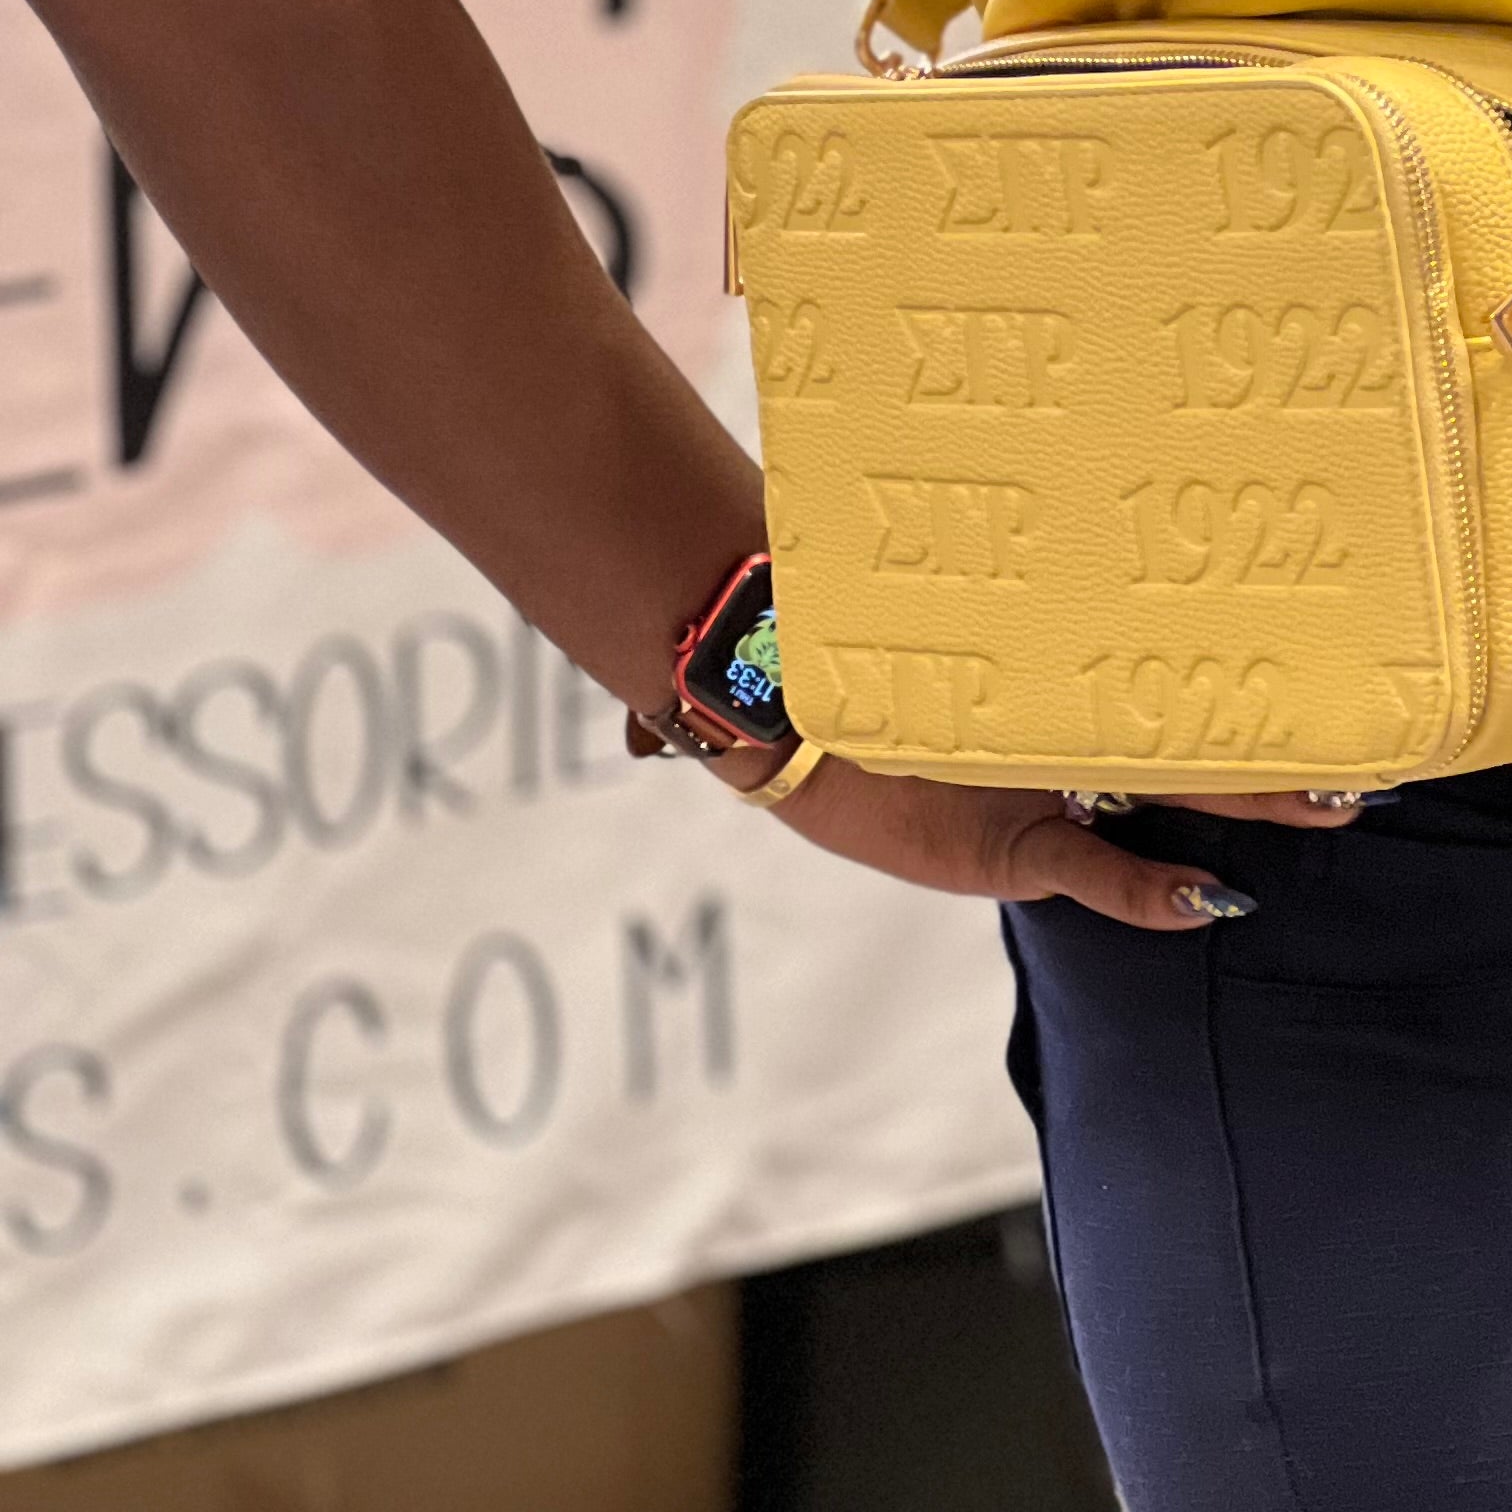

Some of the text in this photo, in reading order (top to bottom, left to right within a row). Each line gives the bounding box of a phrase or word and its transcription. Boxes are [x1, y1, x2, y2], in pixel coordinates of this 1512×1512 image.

[1162, 302, 1400, 411] 1922
[1120, 479, 1349, 588] 1922
[726, 659, 775, 702] 11:33
[1080, 656, 1294, 760] 1922
